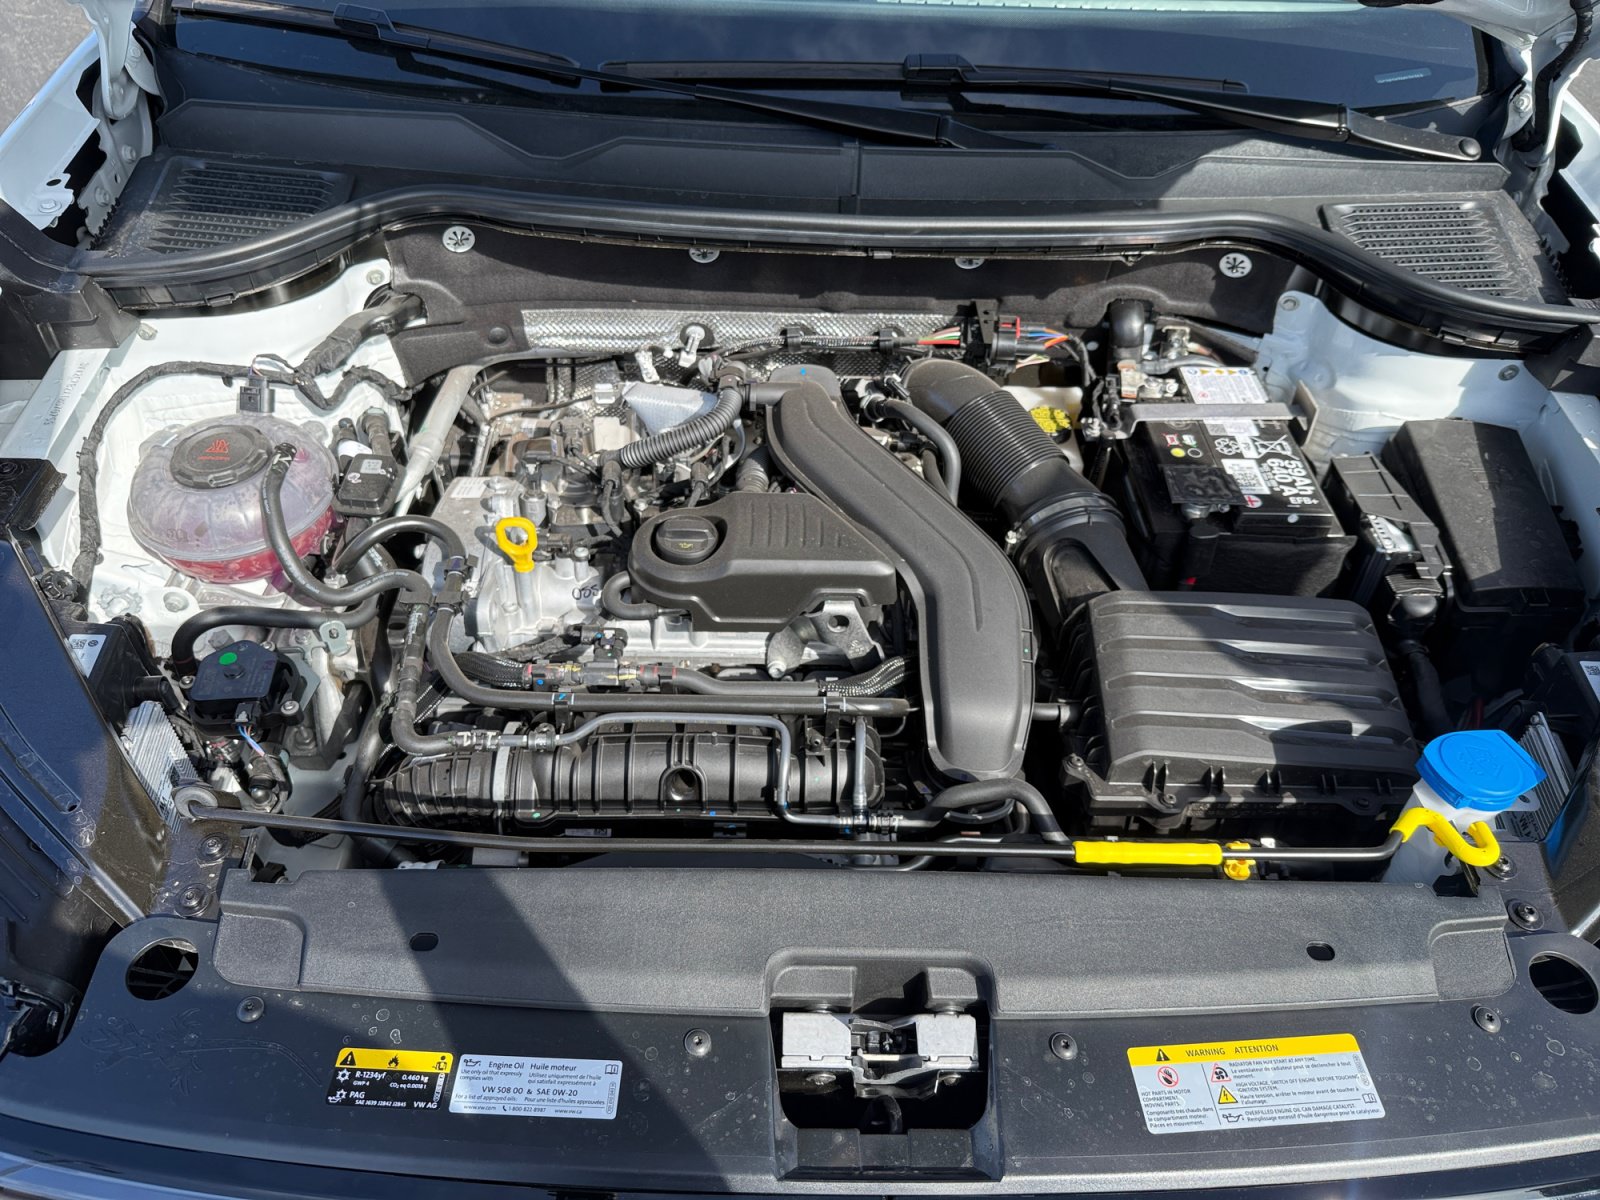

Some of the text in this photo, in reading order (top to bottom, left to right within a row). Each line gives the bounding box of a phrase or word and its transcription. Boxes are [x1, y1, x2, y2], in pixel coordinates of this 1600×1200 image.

[1267, 458, 1292, 483] 640
[1284, 460, 1315, 495] 59Ah
[1279, 484, 1299, 497] A
[1186, 1044, 1279, 1057] WARNING ATTENTION
[488, 1061, 514, 1070] Engine
[355, 1070, 386, 1080] R-1234yf
[420, 1074, 429, 1082] kg
[557, 1079, 591, 1087] expressément
[1147, 1109, 1176, 1117] Composants
[1154, 1114, 1189, 1122] compartiment
